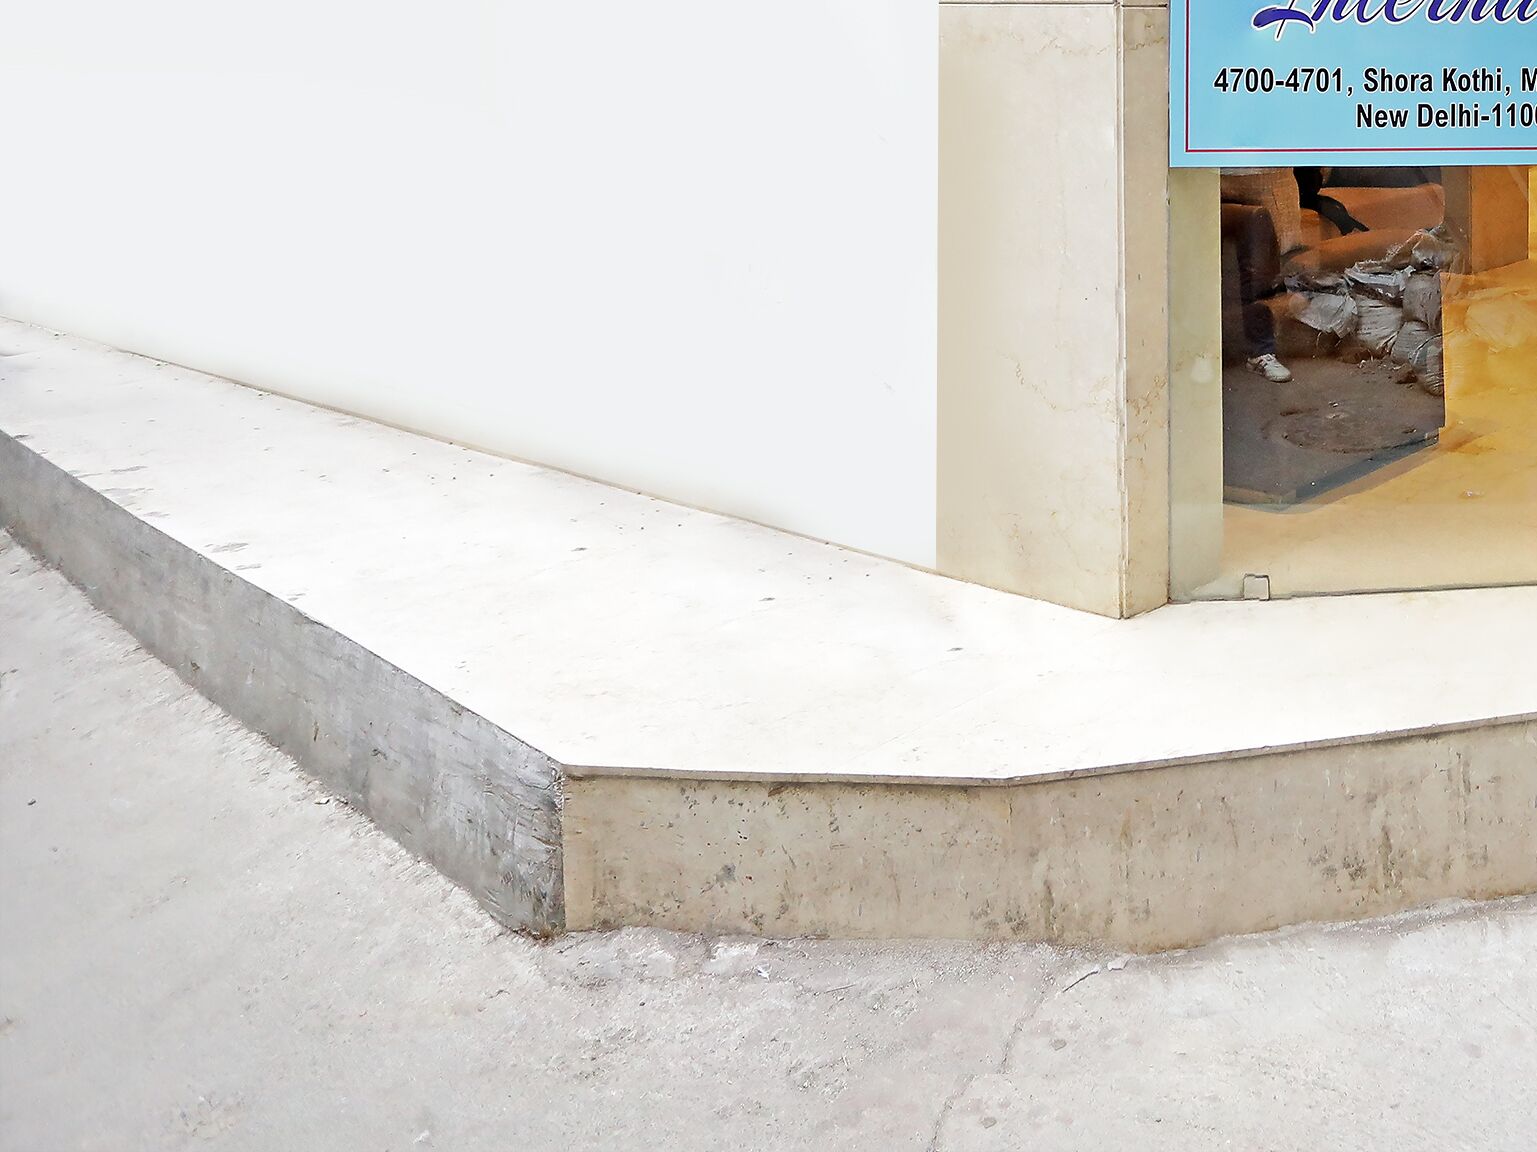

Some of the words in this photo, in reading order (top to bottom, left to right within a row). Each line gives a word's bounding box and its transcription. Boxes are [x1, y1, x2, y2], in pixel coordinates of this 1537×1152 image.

[1213, 67, 1354, 97] 4700-4701,
[1363, 67, 1434, 93] Shora
[1442, 67, 1512, 97] Kothi,
[1356, 103, 1409, 128] New
